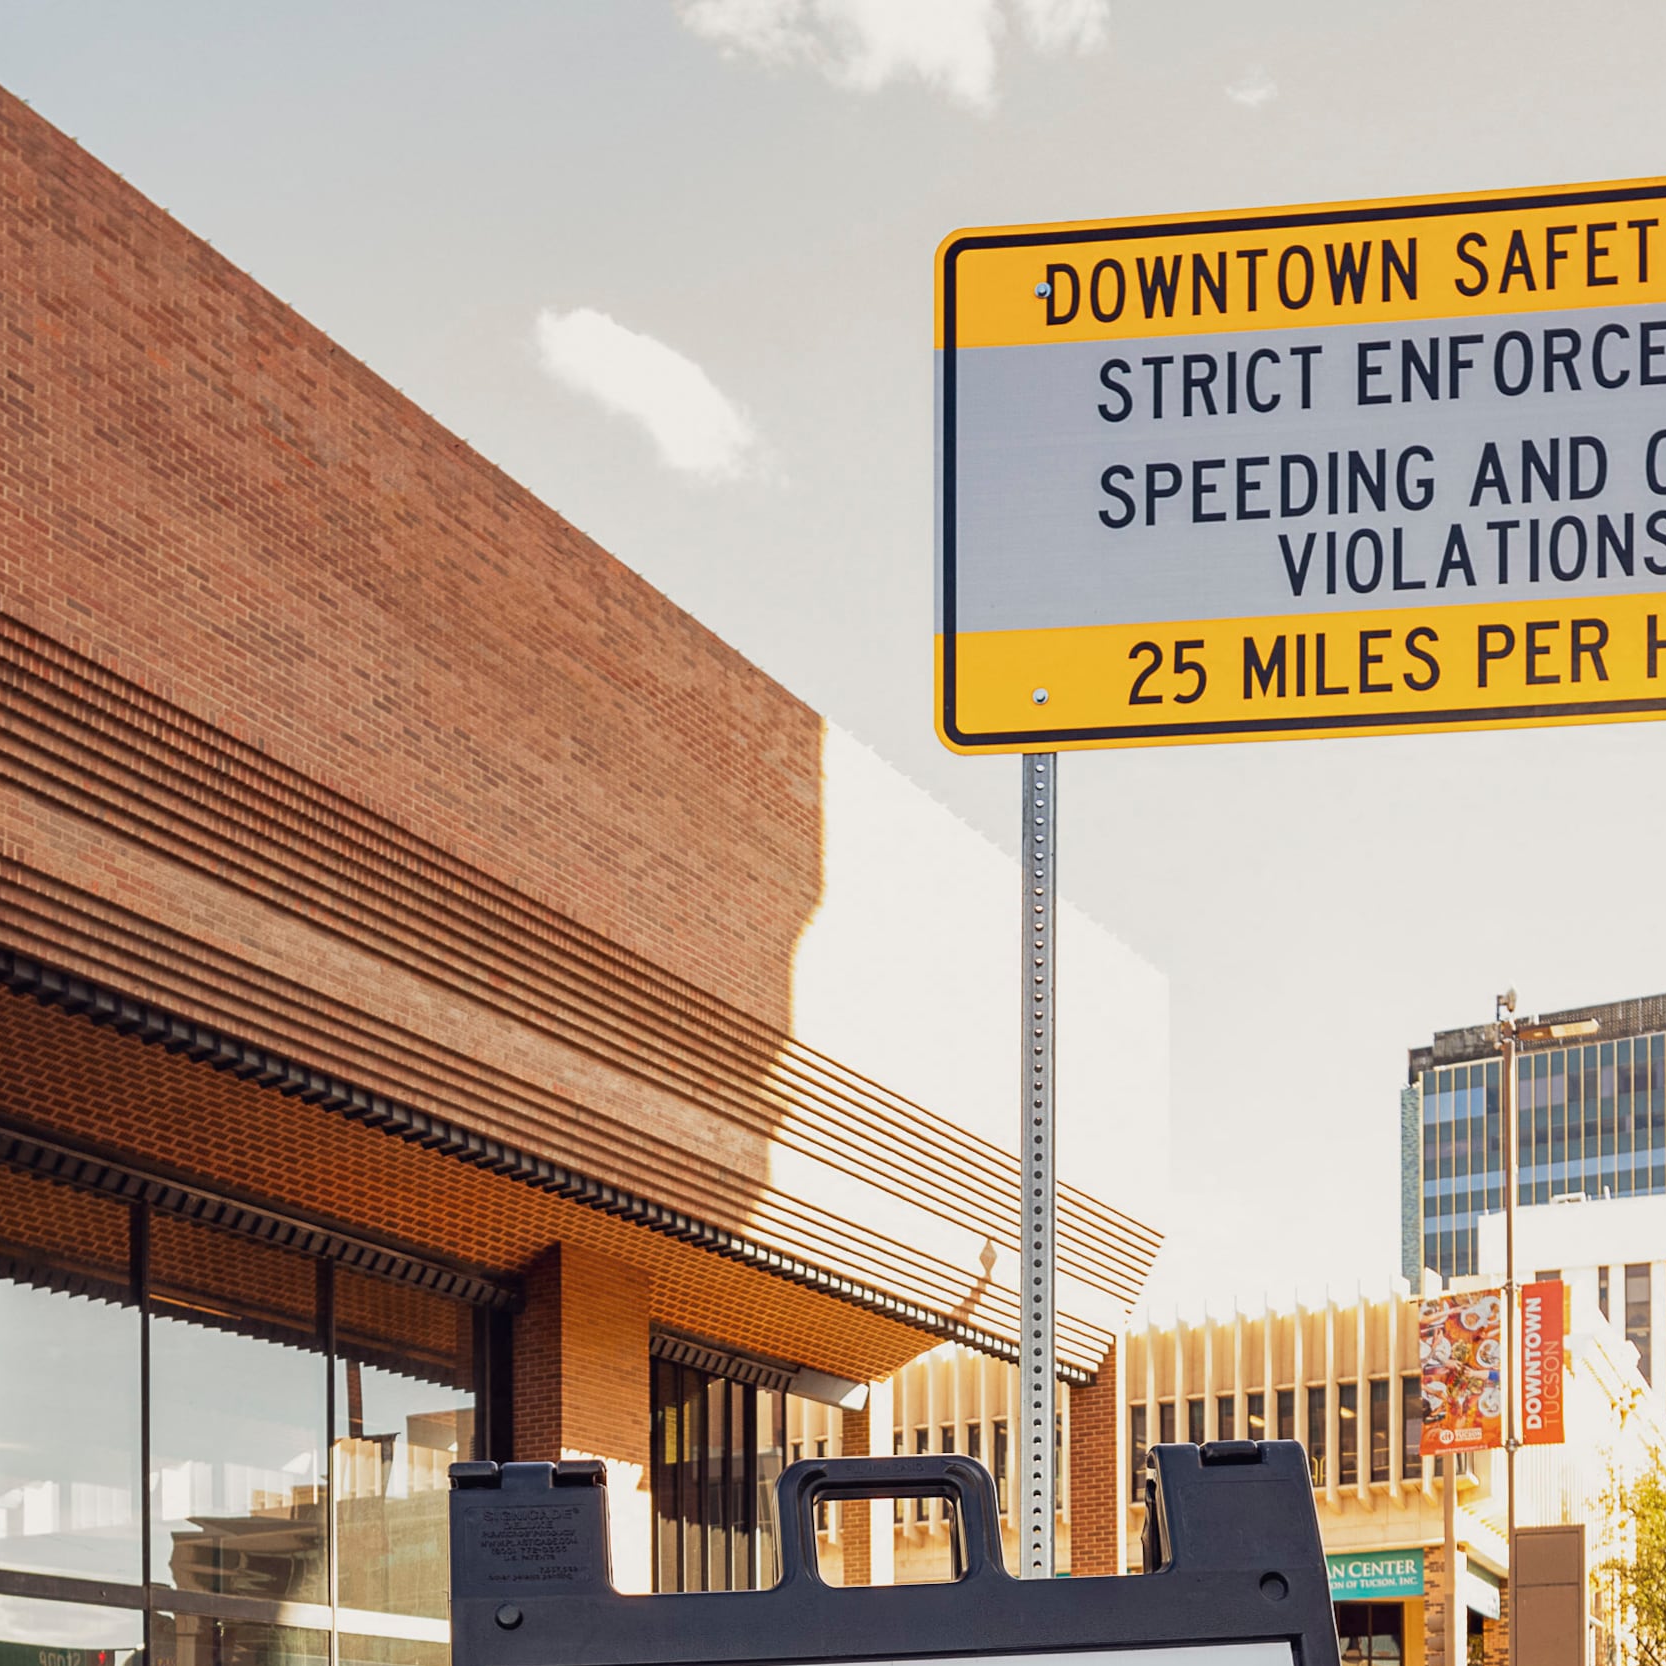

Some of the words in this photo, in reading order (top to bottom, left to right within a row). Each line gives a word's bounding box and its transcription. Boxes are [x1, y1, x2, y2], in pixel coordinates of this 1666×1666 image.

[1045, 237, 1418, 327] DOWNTOWN
[1097, 345, 1323, 423] STRICT
[1098, 444, 1435, 530] SPEEDING
[1469, 435, 1608, 508] AND
[1128, 638, 1207, 706] 25
[1242, 626, 1440, 701] MILES
[1477, 617, 1610, 689] PER
[1525, 1297, 1542, 1430] DOWNTOWN
[1543, 1340, 1560, 1428] TUCSON
